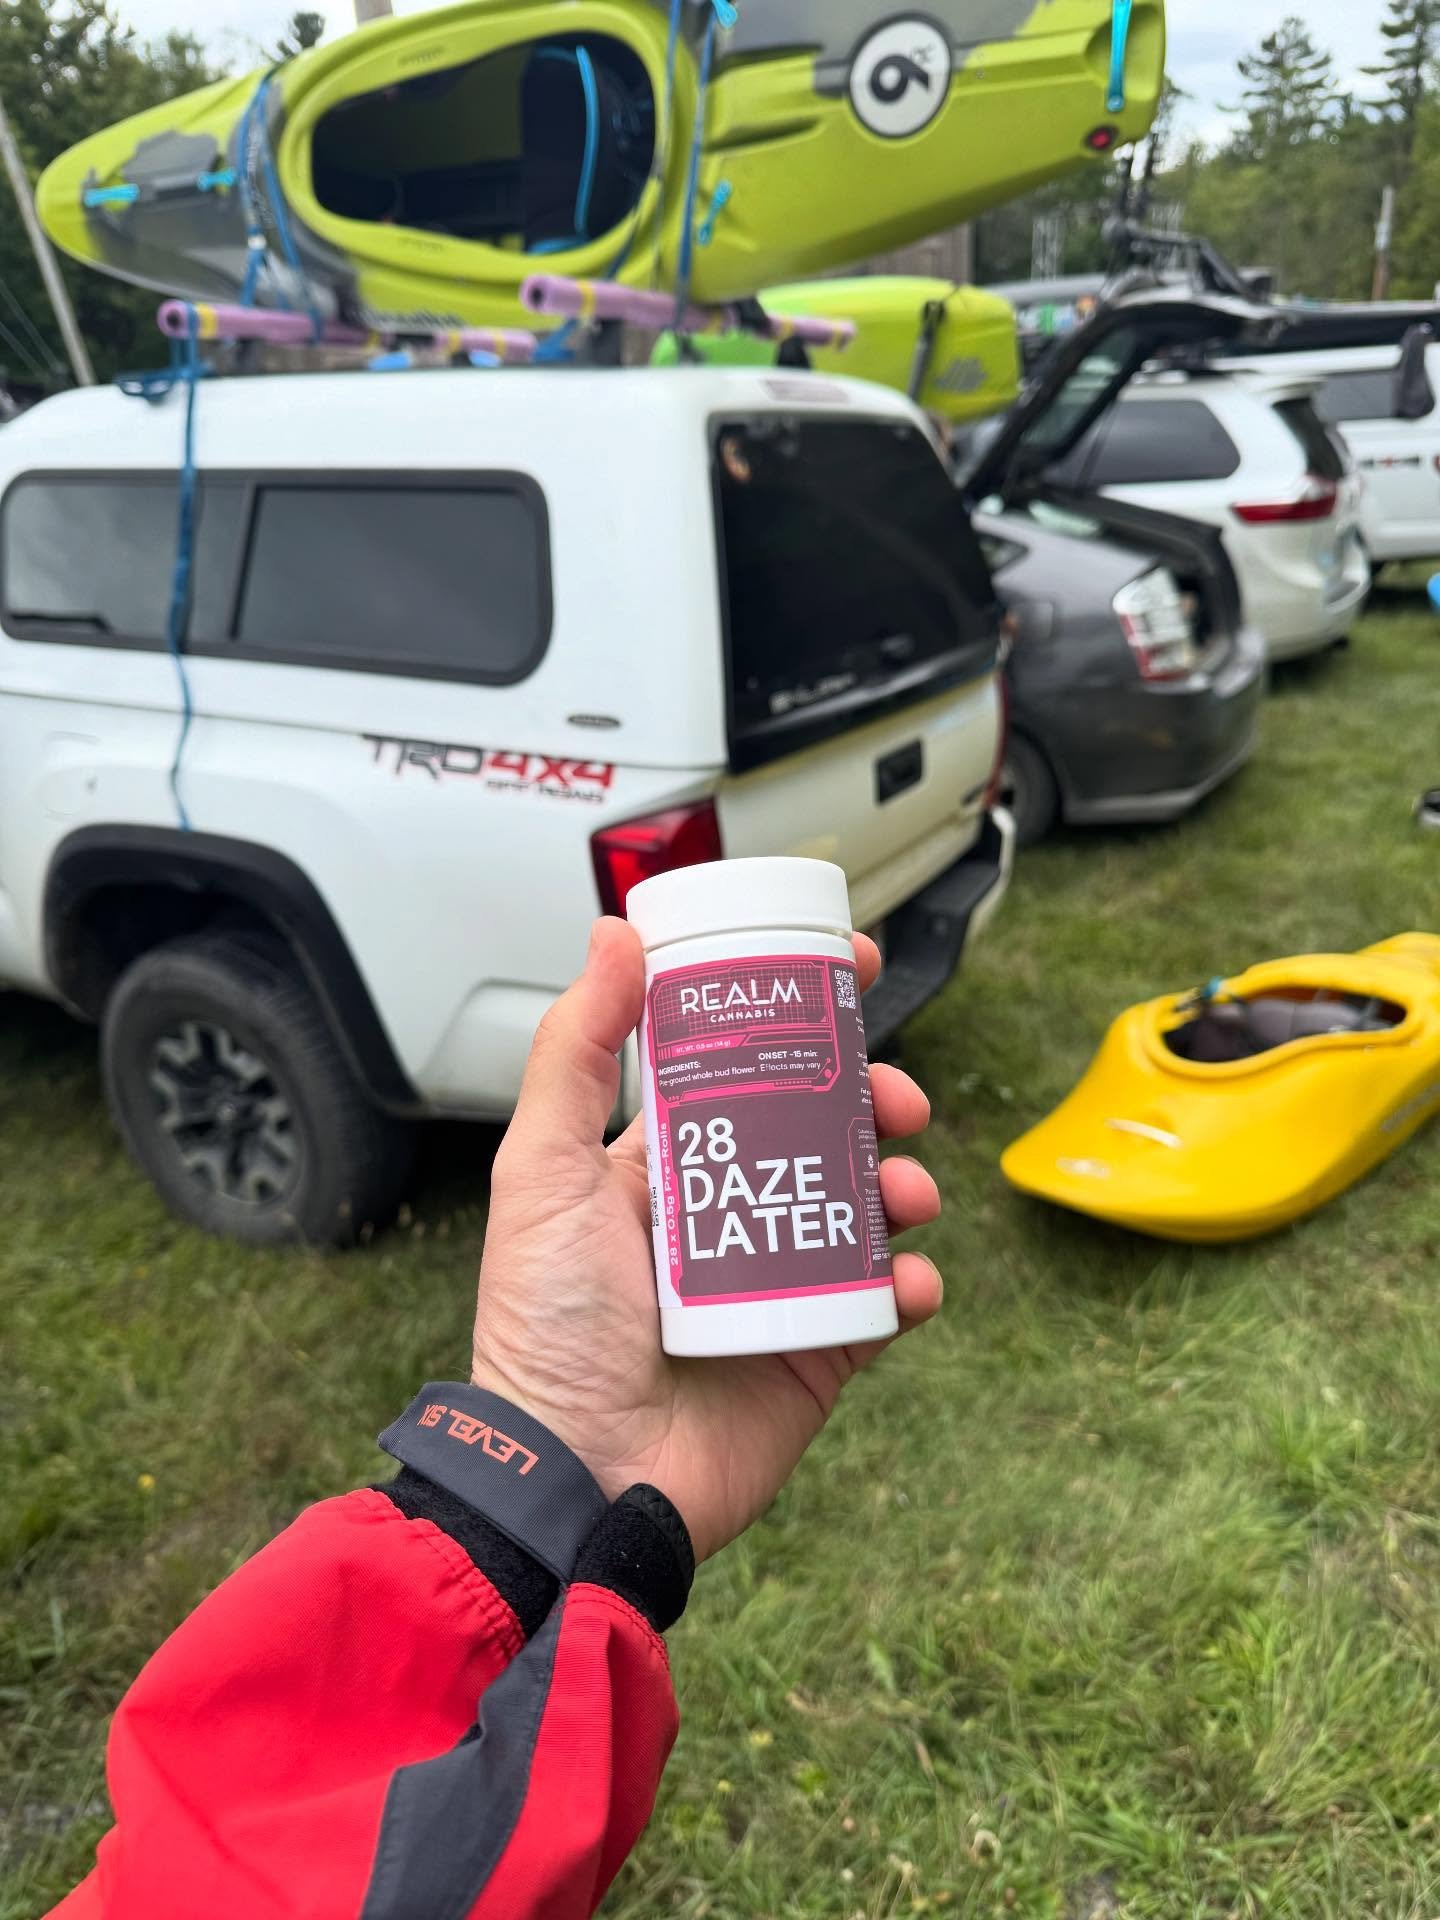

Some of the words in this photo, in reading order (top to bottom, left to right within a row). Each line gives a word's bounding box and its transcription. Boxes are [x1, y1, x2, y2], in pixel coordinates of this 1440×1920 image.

[361, 733, 485, 780] TRD
[680, 977, 802, 1015] REALM
[710, 1009, 776, 1023] CANNABIS
[657, 1061, 701, 1076] INGREDIENTS:
[758, 1051, 788, 1060] ONSET
[760, 1063, 788, 1072] Effects
[789, 1062, 804, 1071] may
[806, 1062, 821, 1070] vary
[659, 1073, 691, 1087] Pre-ground
[691, 1070, 713, 1080] whole
[714, 1068, 730, 1078] bud
[731, 1066, 756, 1076] flower
[660, 1122, 673, 1192] Pre-Rolls
[678, 1117, 737, 1166] 28
[682, 1155, 826, 1213] DAZE
[667, 1195, 675, 1230] 0.5g
[686, 1201, 857, 1260] LATER
[670, 1247, 679, 1266] 28
[447, 1408, 540, 1476] LEVEL
